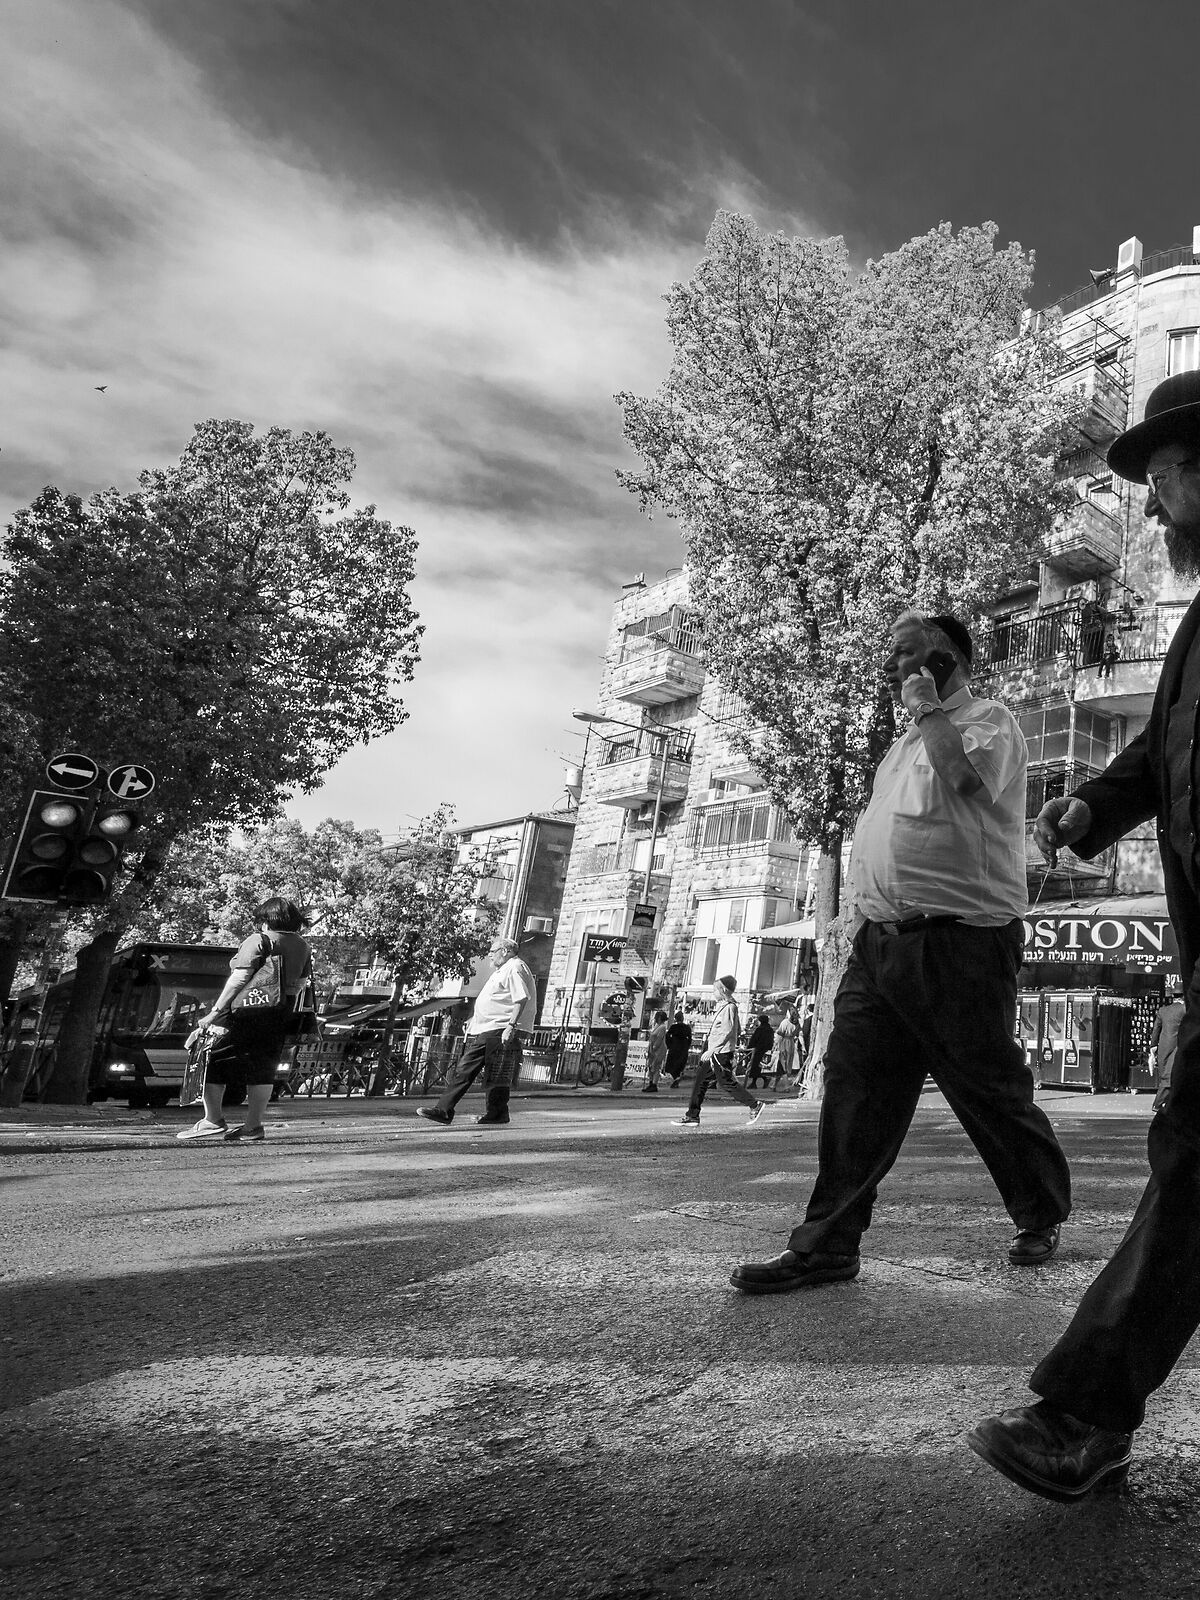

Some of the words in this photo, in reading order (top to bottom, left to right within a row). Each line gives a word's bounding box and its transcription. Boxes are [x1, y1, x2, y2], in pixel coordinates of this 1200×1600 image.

[1048, 949, 1077, 962] הנעלה
[1081, 951, 1104, 962] רשת
[1156, 955, 1173, 963] שיק
[242, 994, 270, 1007] LUXI
